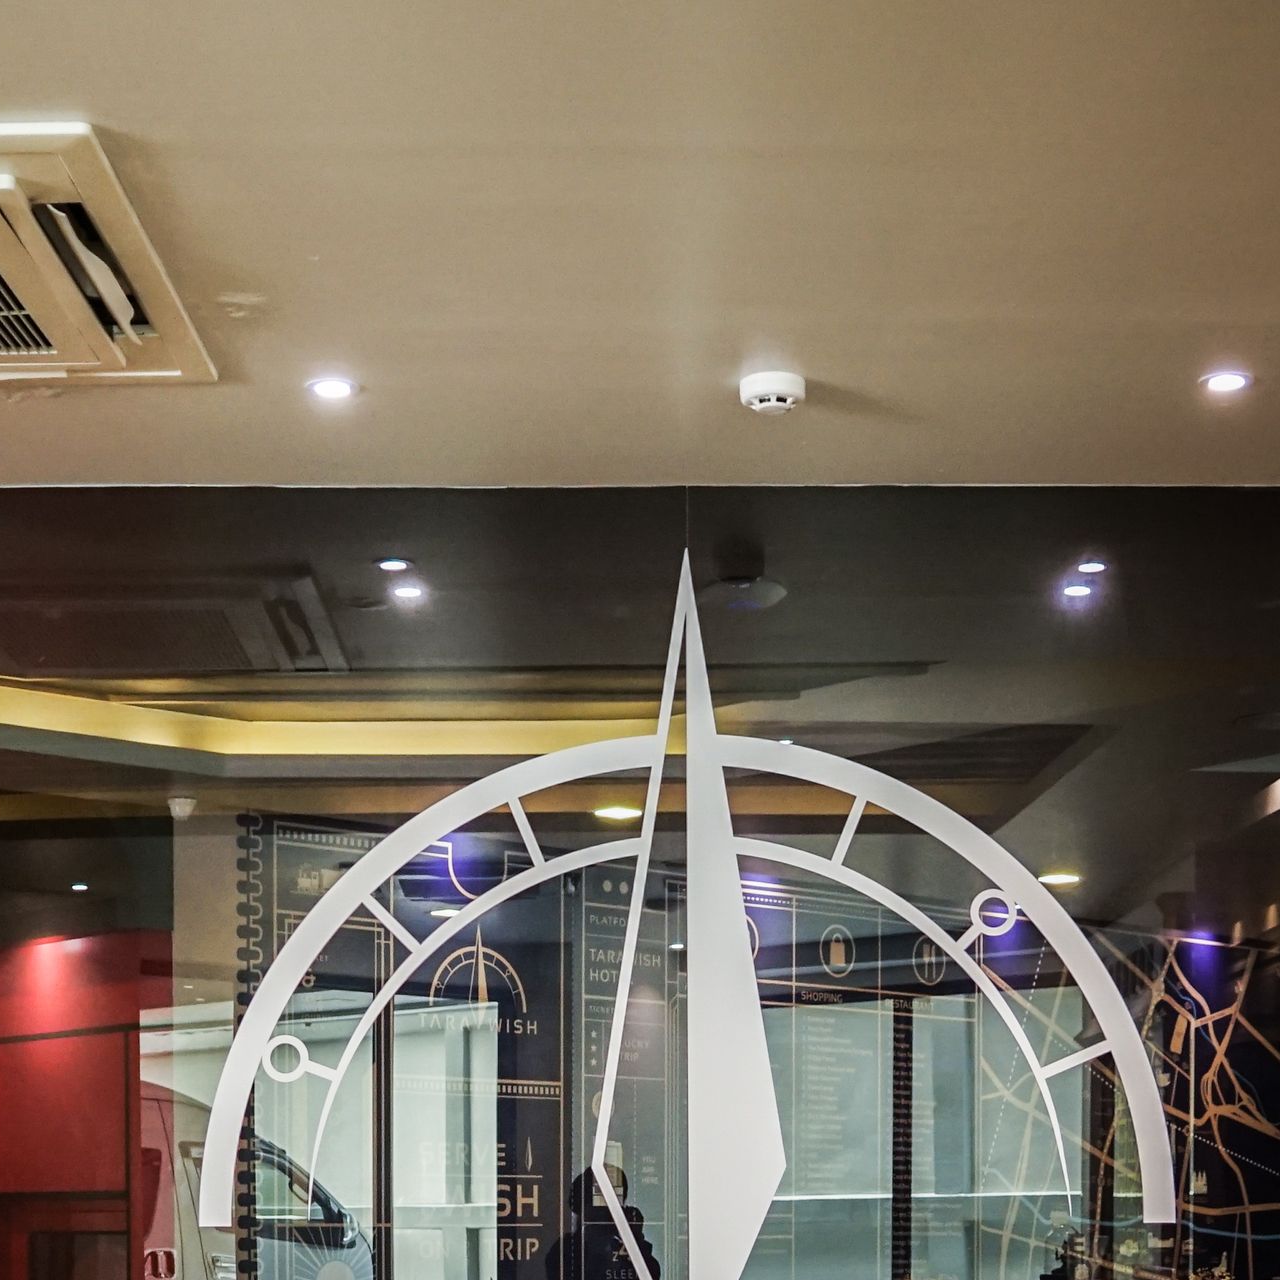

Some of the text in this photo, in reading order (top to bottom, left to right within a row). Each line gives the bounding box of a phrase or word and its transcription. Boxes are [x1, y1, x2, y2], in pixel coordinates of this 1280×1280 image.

[589, 914, 627, 927] PLATFO
[800, 991, 843, 1004] SHOPPING
[419, 1013, 538, 1036] TARA WISH
[623, 1039, 650, 1050] UCKY
